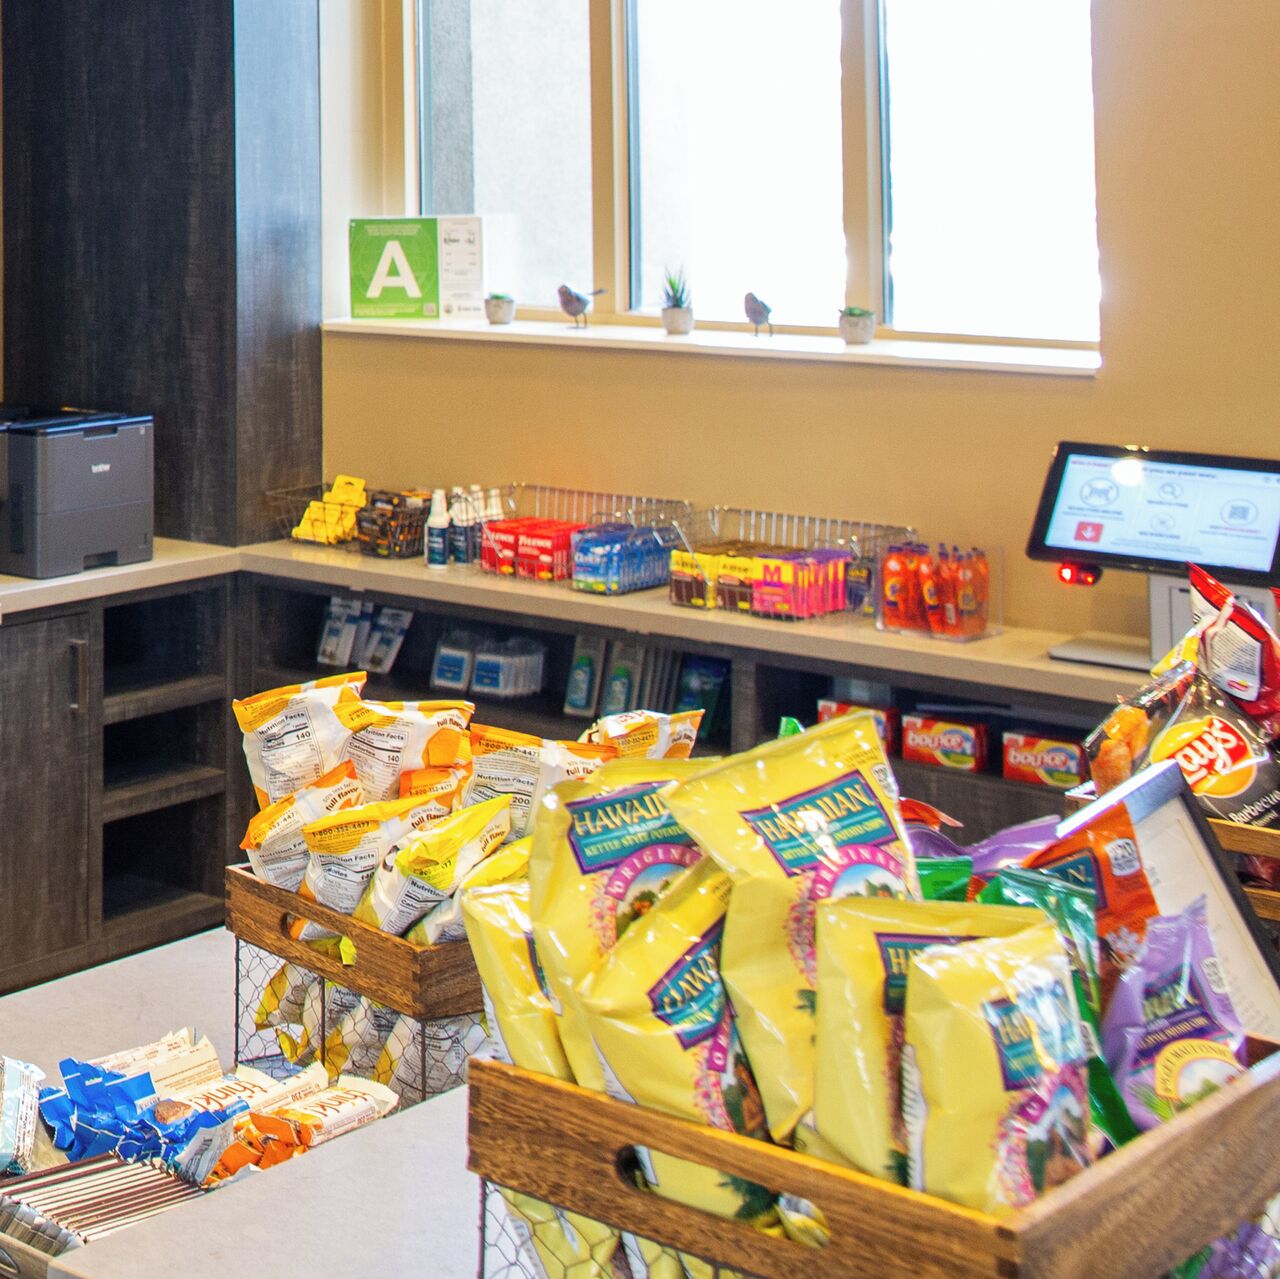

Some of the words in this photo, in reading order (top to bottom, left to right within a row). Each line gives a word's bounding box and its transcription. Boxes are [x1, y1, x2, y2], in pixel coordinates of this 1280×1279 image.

[365, 239, 423, 299] A
[284, 711, 306, 723] Facts
[295, 731, 312, 741] 140
[908, 730, 964, 751] bounce
[386, 753, 400, 763] 140
[1008, 748, 1067, 768] bounce
[1175, 718, 1238, 785] Lay's
[512, 796, 531, 806] 200
[410, 816, 426, 829] full
[572, 793, 667, 837] HAWAII
